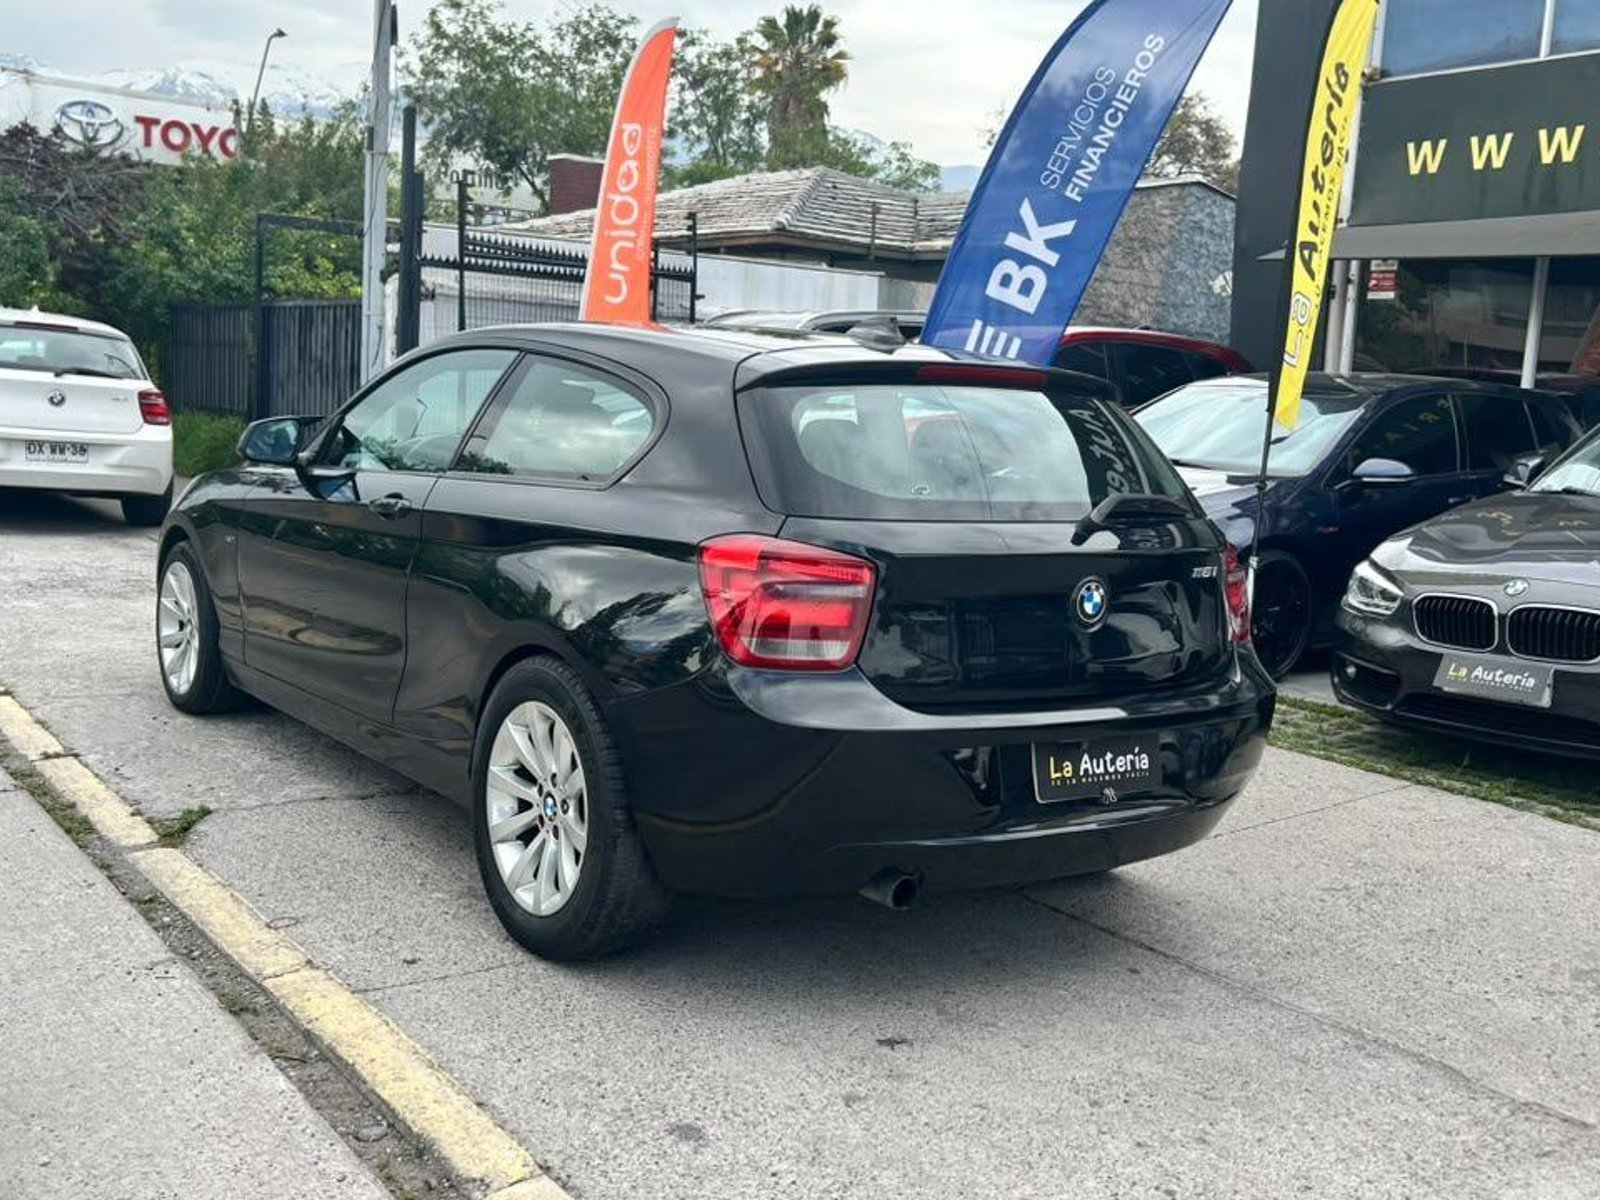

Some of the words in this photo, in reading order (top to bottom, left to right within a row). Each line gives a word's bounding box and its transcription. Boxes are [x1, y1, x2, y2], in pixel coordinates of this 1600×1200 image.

[1040, 65, 1116, 189] SERVICIOS
[1064, 33, 1165, 203] FINANCIEROS
[604, 123, 642, 304] unidad
[985, 197, 1077, 315] BK
[1283, 291, 1312, 368] La
[1448, 663, 1468, 678] La
[1049, 756, 1073, 779] La
[1079, 746, 1149, 776] Autería
